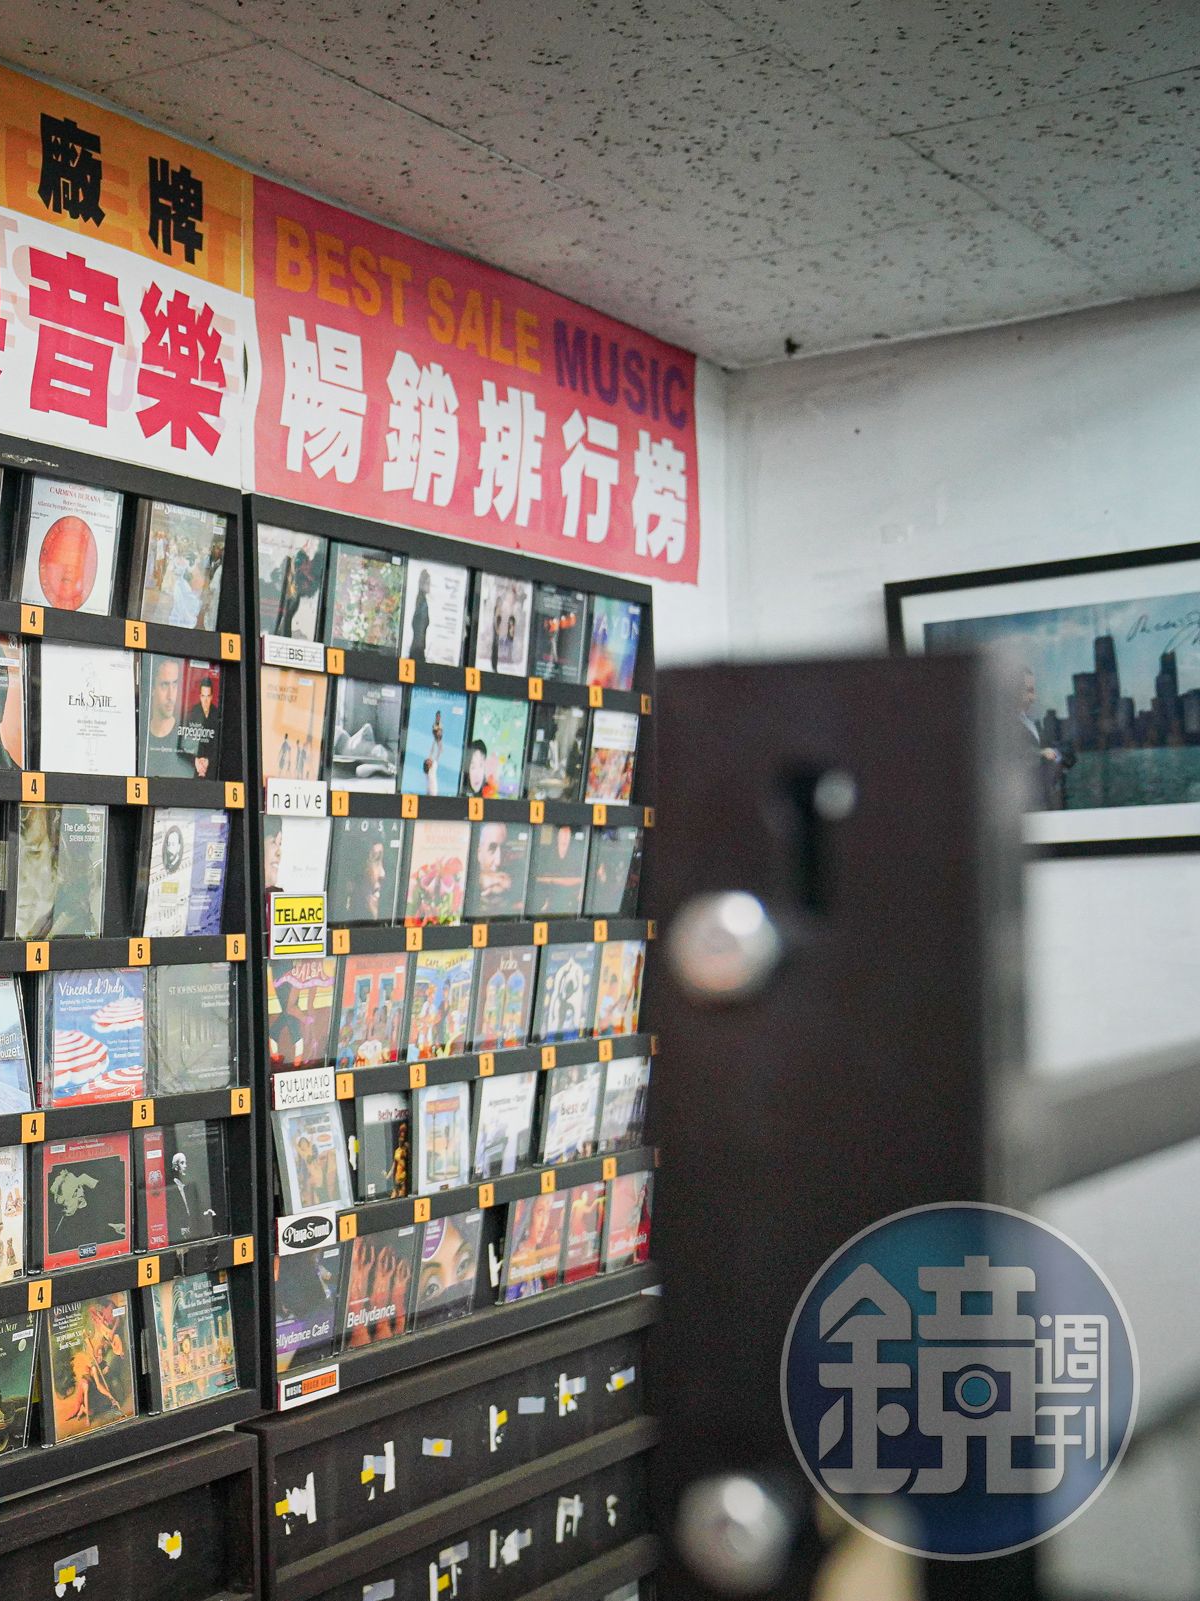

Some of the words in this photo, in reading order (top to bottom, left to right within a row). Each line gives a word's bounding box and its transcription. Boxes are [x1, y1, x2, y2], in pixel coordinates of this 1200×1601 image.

[274, 215, 413, 327] BEST
[426, 275, 542, 375] SALE
[552, 318, 687, 431] MUSIC
[280, 314, 688, 565] 暢銷排行榜
[288, 648, 304, 661] BIS
[68, 691, 86, 706] Erik
[177, 725, 216, 741] arpeggione
[74, 823, 86, 833] Cello
[276, 906, 323, 923] TELARC
[275, 926, 323, 944] JAZZ
[59, 981, 93, 996] Vincent
[279, 1074, 330, 1094] PUTUMAYO
[280, 1093, 305, 1104] World
[378, 1110, 393, 1121] Belly
[347, 1303, 396, 1328] Bellydance
[312, 1320, 330, 1337] Café
[285, 1384, 302, 1398] MUSIC
